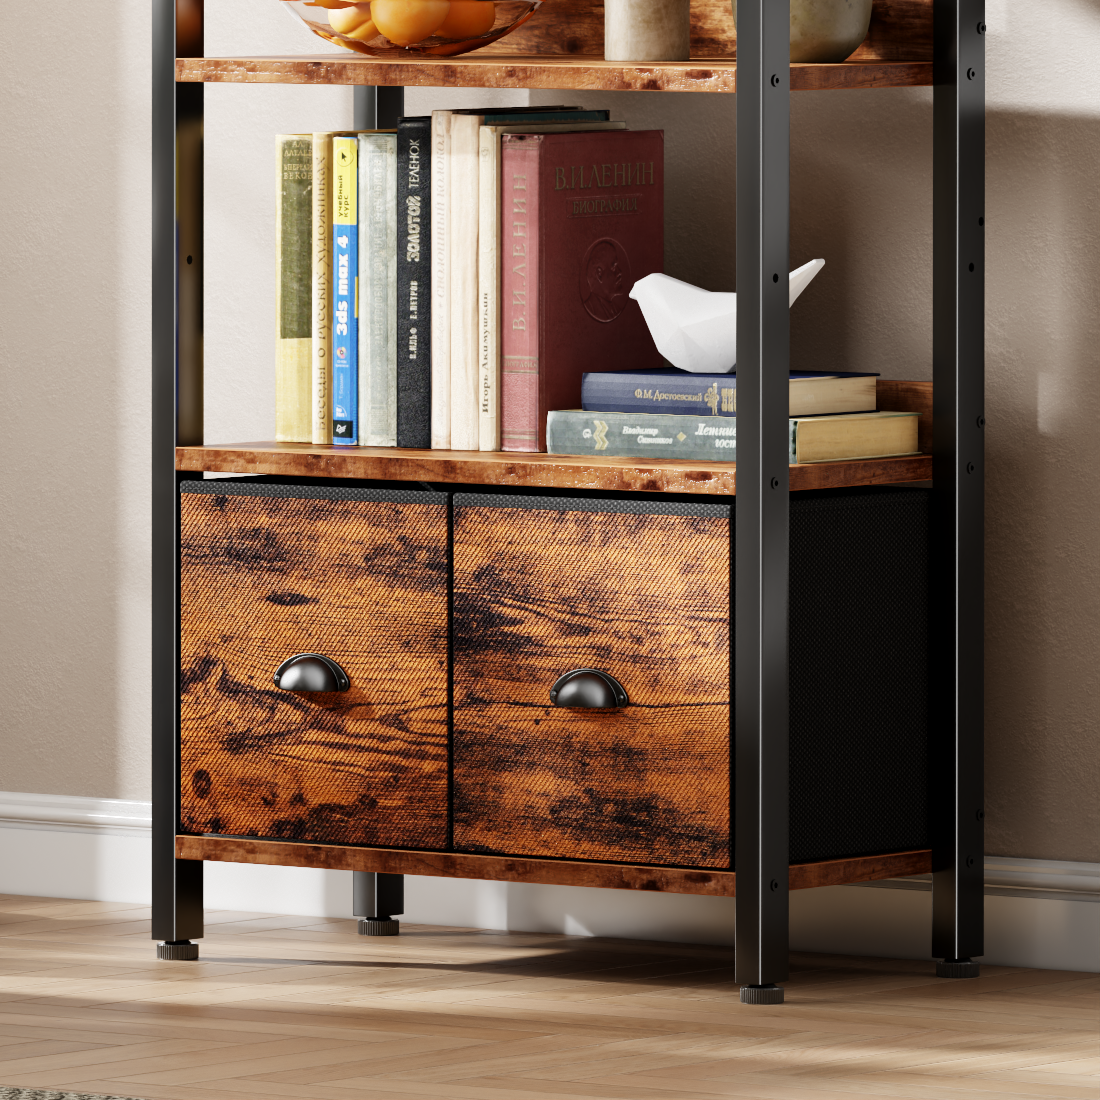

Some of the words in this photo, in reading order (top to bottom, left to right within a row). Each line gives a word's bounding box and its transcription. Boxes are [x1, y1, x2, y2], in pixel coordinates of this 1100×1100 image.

[408, 139, 420, 189] ТЕЛЕНОК
[436, 134, 445, 197] КОЛОКОЛ
[316, 157, 331, 267] художниках
[406, 195, 422, 262] ЗОЛОТОЙ
[572, 198, 638, 215] БИОГРАФИЯ
[337, 234, 349, 249] 4
[338, 253, 349, 296] max
[317, 271, 331, 340] русских
[335, 300, 348, 336] 3ds
[482, 292, 490, 370] Акимушкин
[482, 375, 491, 413] Игорь
